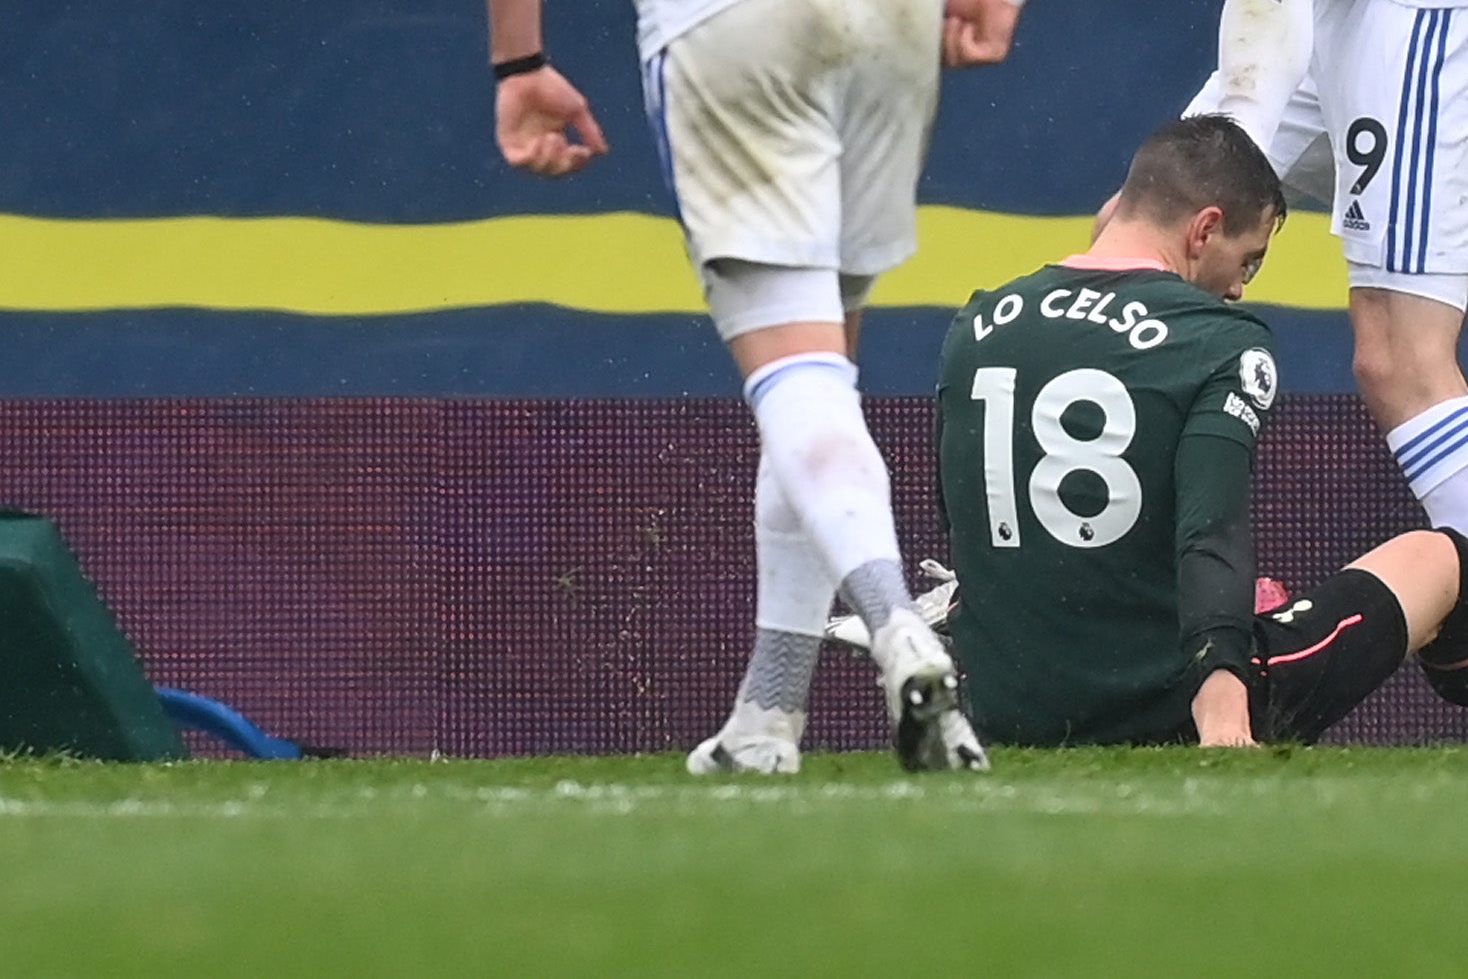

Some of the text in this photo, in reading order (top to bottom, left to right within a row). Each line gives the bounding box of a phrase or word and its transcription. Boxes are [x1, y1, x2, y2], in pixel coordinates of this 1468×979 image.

[1346, 117, 1388, 196] 9
[973, 288, 1169, 350] LO CELSO
[971, 367, 1142, 548] 18
